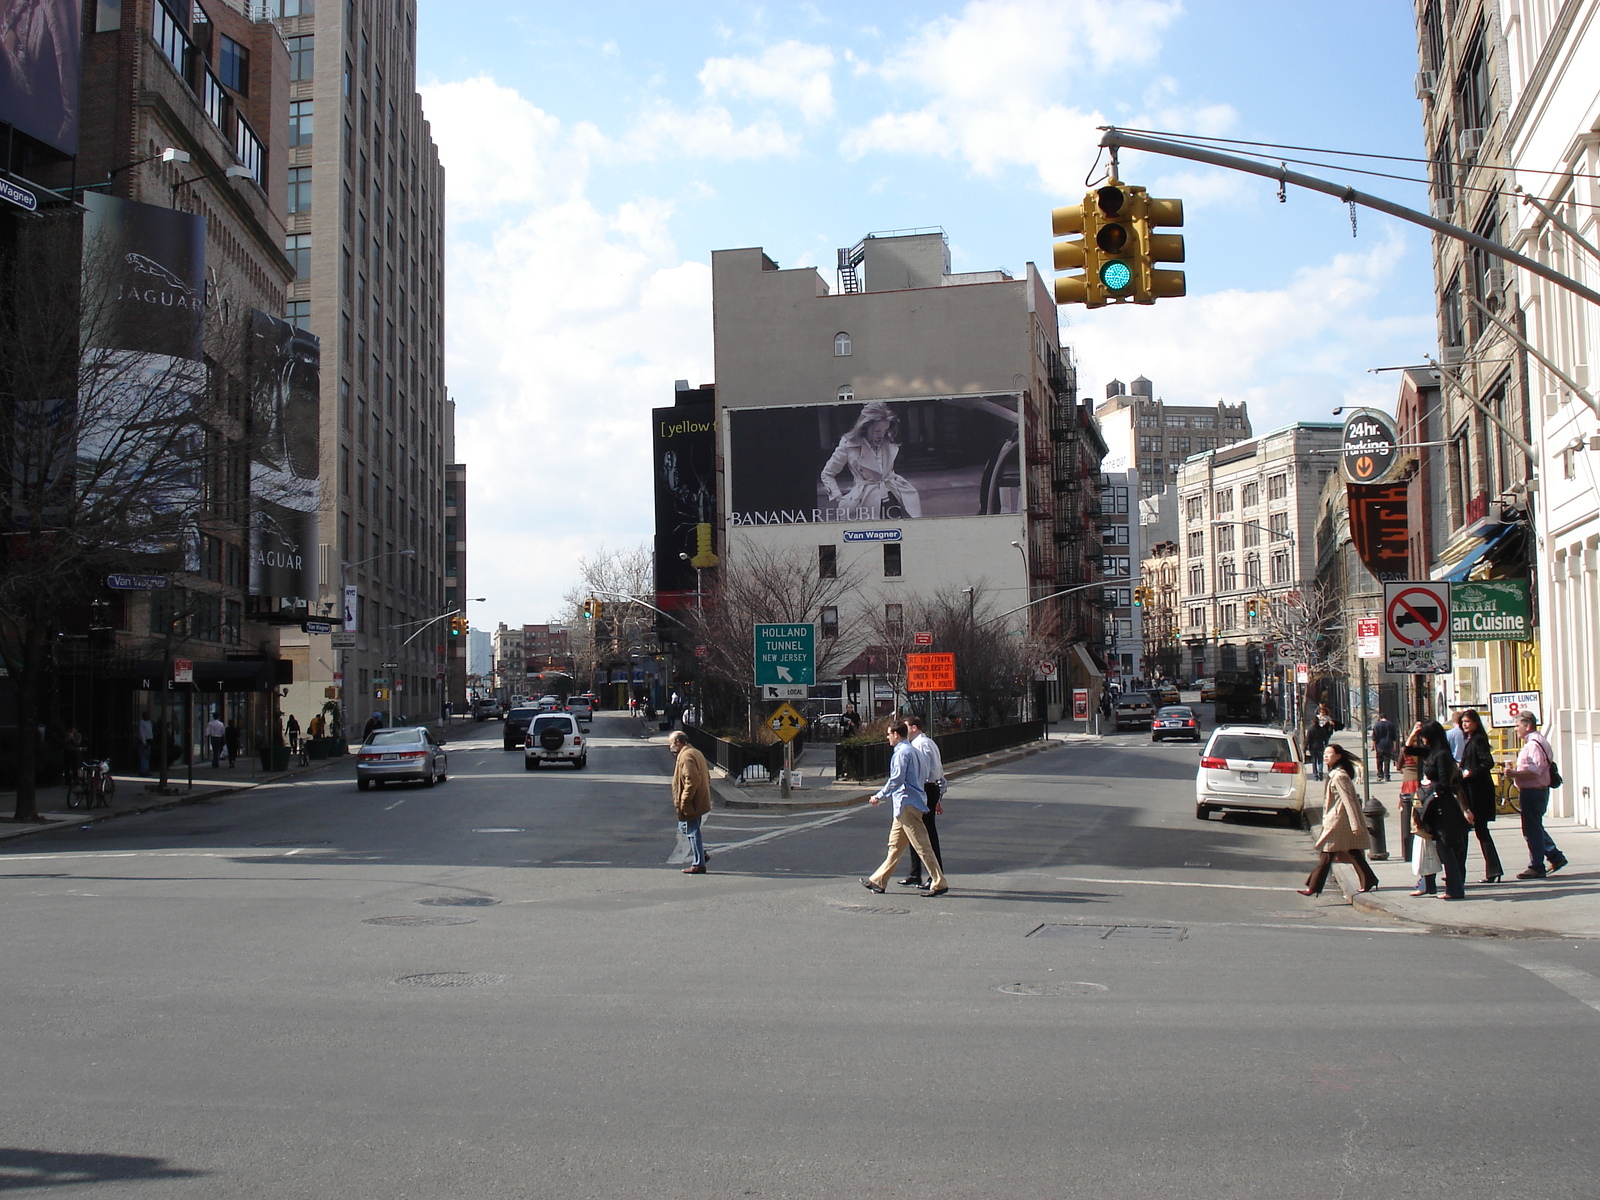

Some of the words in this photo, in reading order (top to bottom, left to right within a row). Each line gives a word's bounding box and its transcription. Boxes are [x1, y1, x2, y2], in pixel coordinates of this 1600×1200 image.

[0, 181, 33, 205] Wagner
[117, 285, 203, 311] JAGUAR
[668, 420, 710, 438] yellow
[1349, 422, 1381, 438] 24hr.
[1345, 439, 1389, 457] Parking
[731, 509, 807, 526] BANANA
[812, 505, 902, 523] REPUBLIC
[848, 532, 864, 540] Van
[865, 531, 898, 541] Wagner
[114, 576, 131, 586] Van
[1453, 617, 1470, 631] an
[1472, 612, 1524, 631] Cuisine
[762, 628, 807, 638] HOLLAND
[766, 641, 804, 651] TUNNEL
[762, 654, 777, 662] NEW
[780, 653, 807, 662] JERSEY
[932, 672, 949, 680] REPAIR
[938, 680, 953, 688] ROUTE
[787, 688, 803, 696] LOCAL
[1493, 696, 1515, 704] BUFFET
[1517, 694, 1538, 702] LUNCH
